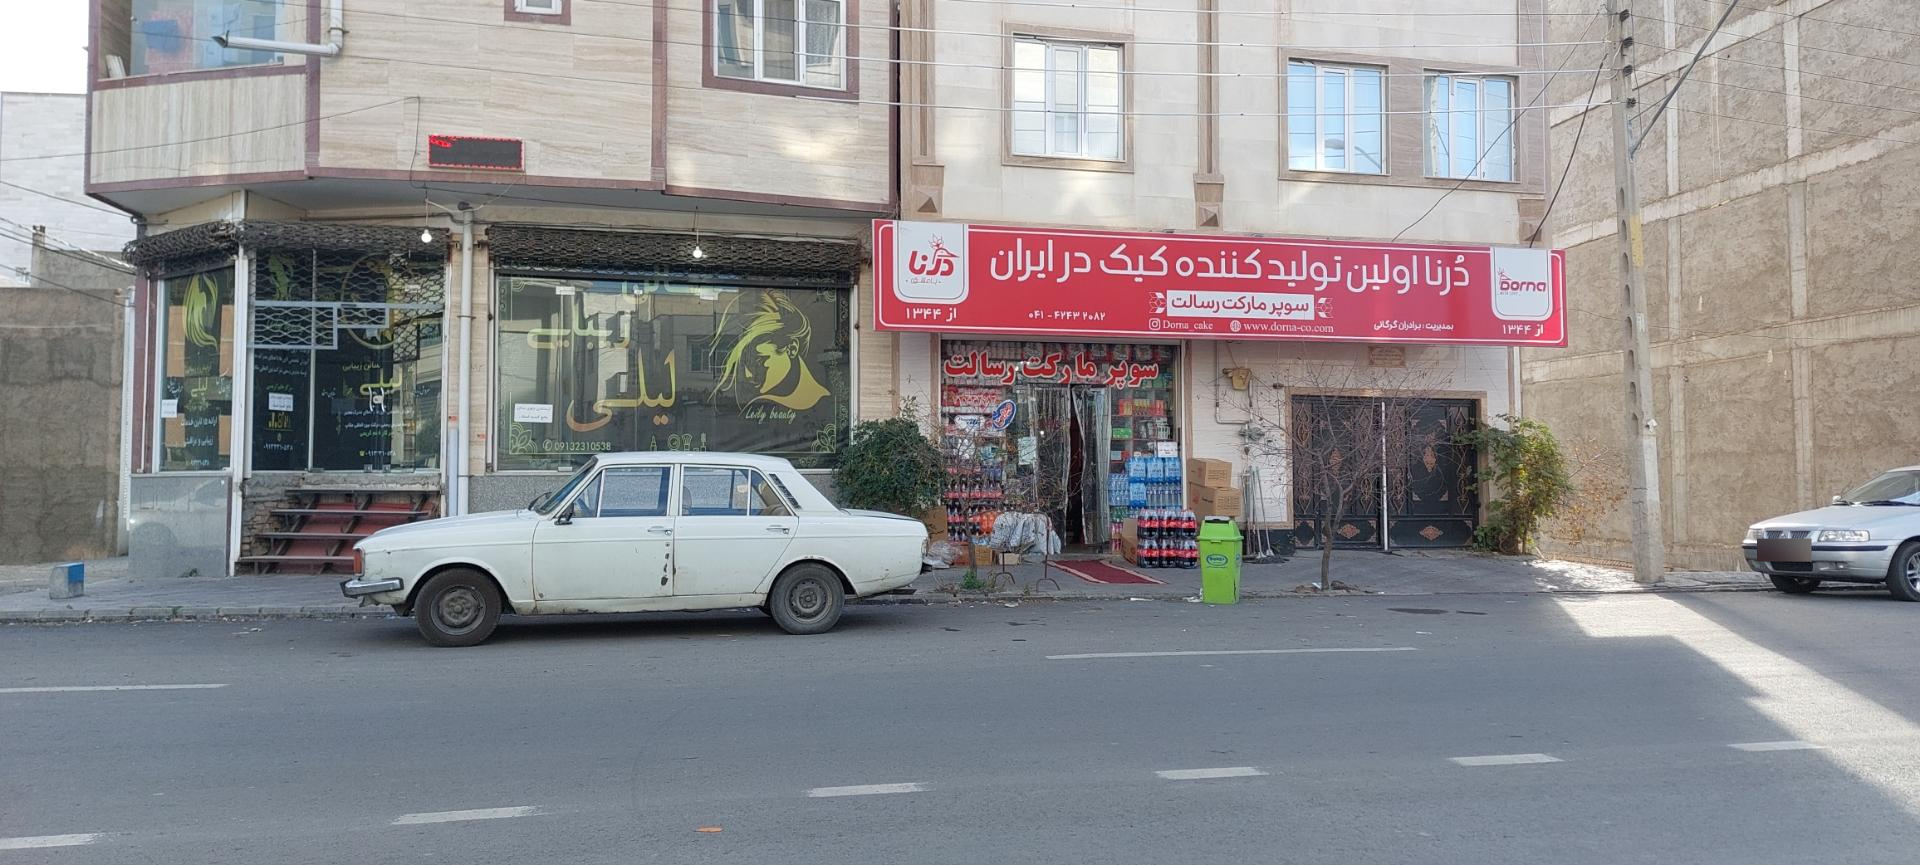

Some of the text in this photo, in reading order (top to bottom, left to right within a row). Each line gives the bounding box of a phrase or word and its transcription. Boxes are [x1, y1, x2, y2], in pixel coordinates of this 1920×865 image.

[909, 250, 954, 276] درنا
[990, 238, 1053, 282] ایران
[1056, 251, 1091, 283] در
[1099, 243, 1168, 282] کیک
[1175, 248, 1262, 279] کننده
[1267, 250, 1342, 291] تولید
[1346, 253, 1417, 295] اولین
[906, 307, 957, 322] از ۱۳۴۴
[1171, 294, 1309, 317] سوپر مارکت رسالت
[1163, 320, 1213, 332] Dorna_cake
[1243, 321, 1334, 333] www.dorna-co.com
[1398, 320, 1421, 331] برادران
[1502, 323, 1544, 337] از ۱۳۴۴
[944, 351, 1016, 385] رسالت
[1103, 360, 1159, 390] سوپر
[566, 350, 676, 432] لیلی
[554, 441, 611, 451] 09132310538
